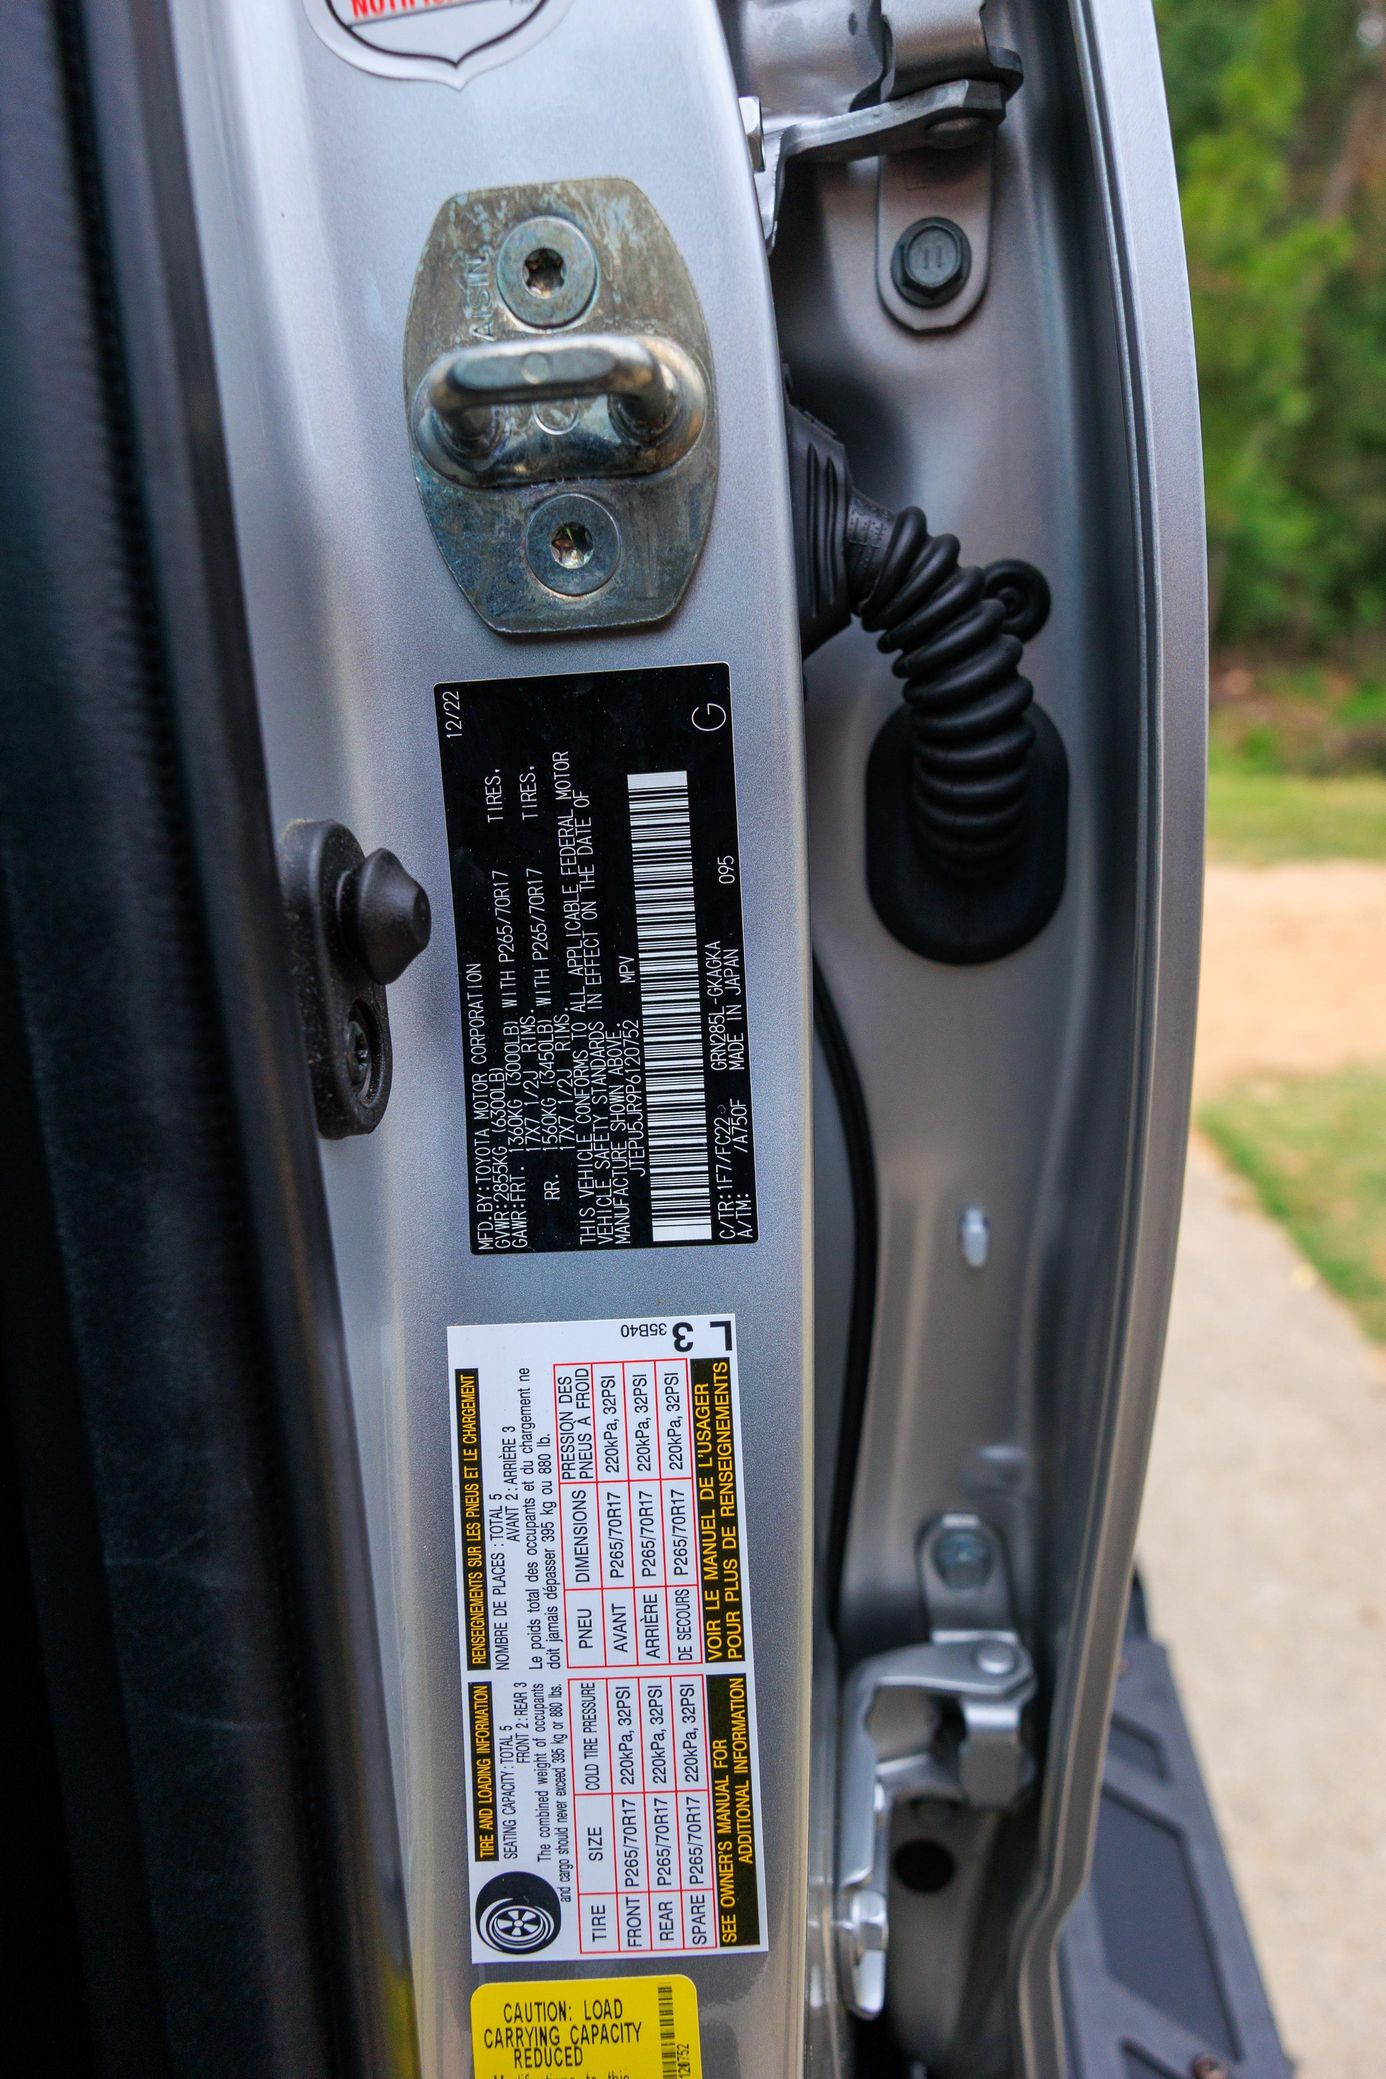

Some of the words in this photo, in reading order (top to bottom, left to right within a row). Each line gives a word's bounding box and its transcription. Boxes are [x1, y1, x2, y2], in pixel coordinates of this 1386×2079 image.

[441, 691, 463, 739] 12/22
[691, 702, 727, 732] G
[552, 751, 572, 800] MOTOR
[572, 789, 590, 808] OF
[557, 808, 577, 876] FEDERAL
[574, 817, 594, 856] DATE
[577, 864, 595, 893] THE
[717, 855, 736, 885] 095
[491, 870, 515, 963] P265/70R17
[525, 868, 549, 961] P265/70R17
[561, 884, 584, 977] APPLICABLE
[580, 901, 598, 921] ON
[582, 930, 602, 986] EFFECT
[618, 955, 636, 984] MPV
[722, 948, 742, 996] JAPAN
[499, 970, 518, 1009] WITH
[533, 968, 552, 1007] WITH
[569, 985, 586, 1013] ALL
[586, 993, 603, 1010] IN
[704, 940, 728, 1071] GRN285L-GKAGKA
[465, 963, 487, 1065] CORPORATION
[519, 1009, 537, 1053] RIMS.
[553, 1007, 571, 1052] RIMS.
[570, 1022, 588, 1040] TO
[725, 1004, 743, 1021] IN
[502, 1021, 522, 1086] (3000LB)
[536, 1019, 556, 1085] (3450LB)
[587, 1021, 608, 1105] STANDARDS
[604, 1023, 624, 1076] ABOVE.
[726, 1032, 745, 1071] MADE
[471, 1072, 490, 1120] MOTOR
[488, 1067, 507, 1133] (6300LB)
[522, 1070, 540, 1106] 1/2J
[556, 1068, 574, 1105] 1/2J
[572, 1049, 592, 1125] CONFORMS
[621, 1019, 646, 1177] JTEPU5JR9P6120752
[506, 1099, 525, 1153] 1360KG
[540, 1097, 559, 1152] 1560KG
[608, 1084, 627, 1132] SHOWN
[524, 1117, 542, 1152] 17X7
[557, 1115, 576, 1151] 17X7
[592, 1113, 611, 1170] SAFETY
[575, 1133, 595, 1199] VEHICLE
[543, 1174, 561, 1200] RR.
[610, 1140, 631, 1245] MANUFACTURE
[578, 1207, 596, 1246] THIS
[594, 1178, 614, 1245] VEHICLE
[735, 1193, 753, 1238] A/TM:
[620, 1322, 668, 1338] 35B40
[672, 1321, 694, 1352] 3
[709, 1320, 733, 1352] L
[518, 1367, 530, 1382] ne
[557, 1376, 573, 1404] DES
[574, 1368, 591, 1409] FROID
[460, 1374, 478, 1445] CHARGEMENT
[600, 1375, 617, 1415] 32PSI
[517, 1387, 536, 1454] chargement
[572, 1416, 592, 1426] À
[712, 1361, 735, 1517] RENSEIGNEMENTS
[463, 1448, 478, 1462] LE
[536, 1436, 551, 1447] lb.
[559, 1411, 577, 1480] PRESSION
[577, 1432, 594, 1479] PNEUS
[603, 1418, 620, 1473] 220kPa,
[463, 1465, 479, 1479] ET
[519, 1460, 535, 1475] du
[537, 1453, 552, 1474] 880
[464, 1483, 481, 1518] PNEUS
[521, 1480, 535, 1492] et
[541, 1480, 553, 1495] ou
[698, 1476, 715, 1501] DE
[522, 1497, 540, 1556] occupants
[539, 1501, 557, 1515] kg
[465, 1522, 481, 1542] LES
[540, 1521, 555, 1543] 395
[571, 1489, 590, 1583] DIMENSIONS
[606, 1491, 625, 1578] P265/70R17
[700, 1508, 719, 1581] MANUEL
[721, 1525, 737, 1550] DE
[467, 1545, 483, 1568] SUR
[524, 1561, 539, 1583] des
[542, 1548, 561, 1600] dépasser
[722, 1558, 740, 1602] PLUS
[467, 1571, 487, 1664] RENSEIGNEMENTS
[525, 1588, 541, 1614] total
[674, 1588, 692, 1641] SECOURS
[704, 1589, 720, 1611] LE
[526, 1618, 546, 1650] poids
[547, 1606, 564, 1643] jamais
[577, 1608, 593, 1649] PNEU
[611, 1603, 628, 1653] AVANT
[639, 1593, 661, 1659] ARRIÈRE
[706, 1619, 723, 1661] VOIR
[725, 1610, 743, 1659] POUR
[528, 1656, 543, 1670] Le
[546, 1647, 561, 1670] doit
[677, 1645, 693, 1661] DE
[530, 1683, 548, 1733] occupants
[548, 1685, 562, 1698] lbs.
[548, 1702, 564, 1718] 880
[580, 1682, 597, 1733] PRESSURE
[615, 1686, 632, 1726] 32PSI
[647, 1685, 664, 1725] 32PSI
[473, 1685, 491, 1754] INFORMATION
[550, 1733, 568, 1745] kg
[552, 1721, 564, 1730] or
[728, 1677, 749, 1774] INFORMATION
[532, 1737, 547, 1748] of
[550, 1748, 566, 1764] 395
[583, 1737, 599, 1760] TIRE
[618, 1730, 635, 1785] 220kPa,
[650, 1729, 667, 1784] 220kPa,
[712, 1739, 729, 1769] FOR
[476, 1758, 493, 1804] LOADING
[533, 1752, 552, 1785] weight
[551, 1767, 567, 1797] exceed
[584, 1763, 601, 1791] COLD
[478, 1808, 494, 1831] AND
[534, 1790, 551, 1838] combined
[556, 1800, 568, 1823] never
[714, 1775, 732, 1834] MANUAL
[734, 1779, 753, 1864] ADDITIONAL
[479, 1834, 495, 1859] TIRE
[536, 1843, 551, 1863] The
[554, 1827, 570, 1855] should
[587, 1826, 604, 1862] SIZE
[621, 1798, 640, 1887] P265/70R17
[558, 1858, 574, 1883] cargo
[556, 1886, 572, 1903] and
[590, 1904, 607, 1943] TIRE
[625, 1896, 642, 1948] FRONT
[658, 1901, 675, 1941] REAR
[690, 1894, 708, 1945] SPARE
[721, 1914, 738, 1943] SEE
[503, 2001, 572, 2024] CAUTION:
[583, 1999, 623, 2021] LOAD
[484, 2025, 560, 2049] CARRYING
[570, 2021, 642, 2045] CAPACITY
[513, 2046, 583, 2069] REDUCED
